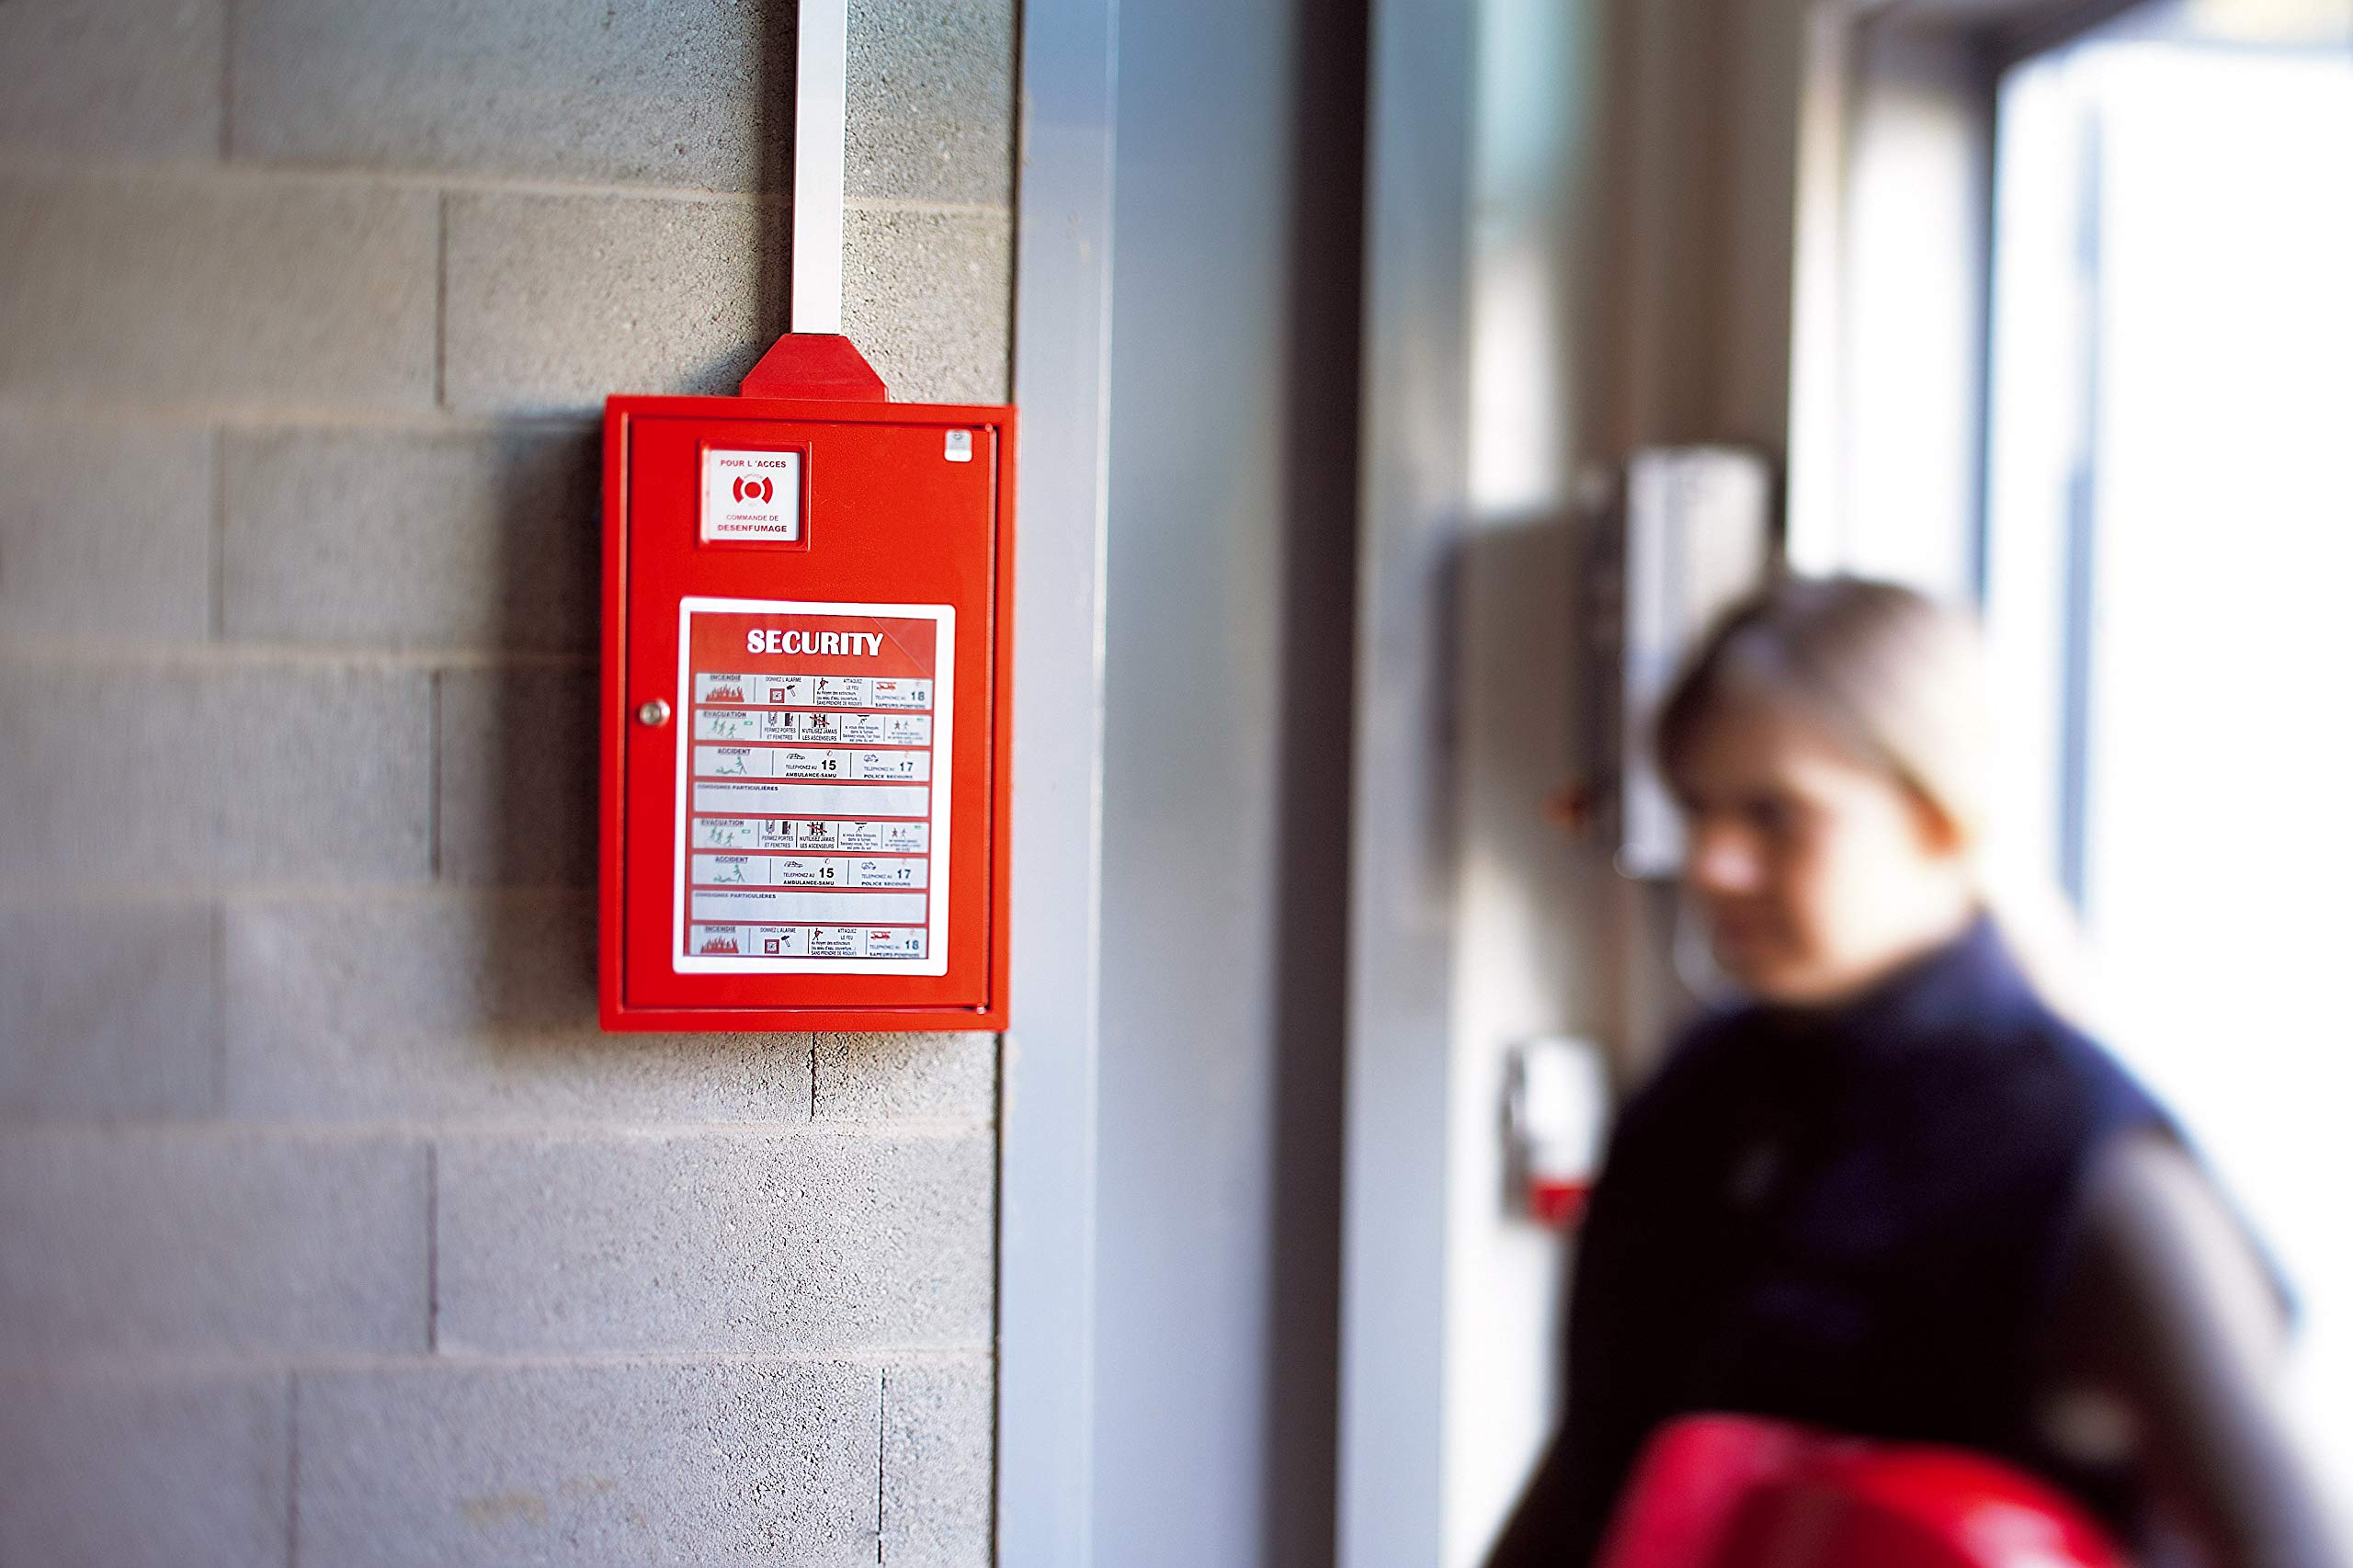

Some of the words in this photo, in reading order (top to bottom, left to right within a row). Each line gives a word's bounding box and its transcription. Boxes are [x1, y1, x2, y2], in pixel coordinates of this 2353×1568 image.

[746, 629, 884, 656] SECURITY
[912, 691, 925, 701] 18
[822, 760, 836, 770] 15
[900, 762, 914, 771] 17
[819, 868, 834, 878] 15
[898, 869, 911, 879] 17
[905, 940, 919, 949] 18
